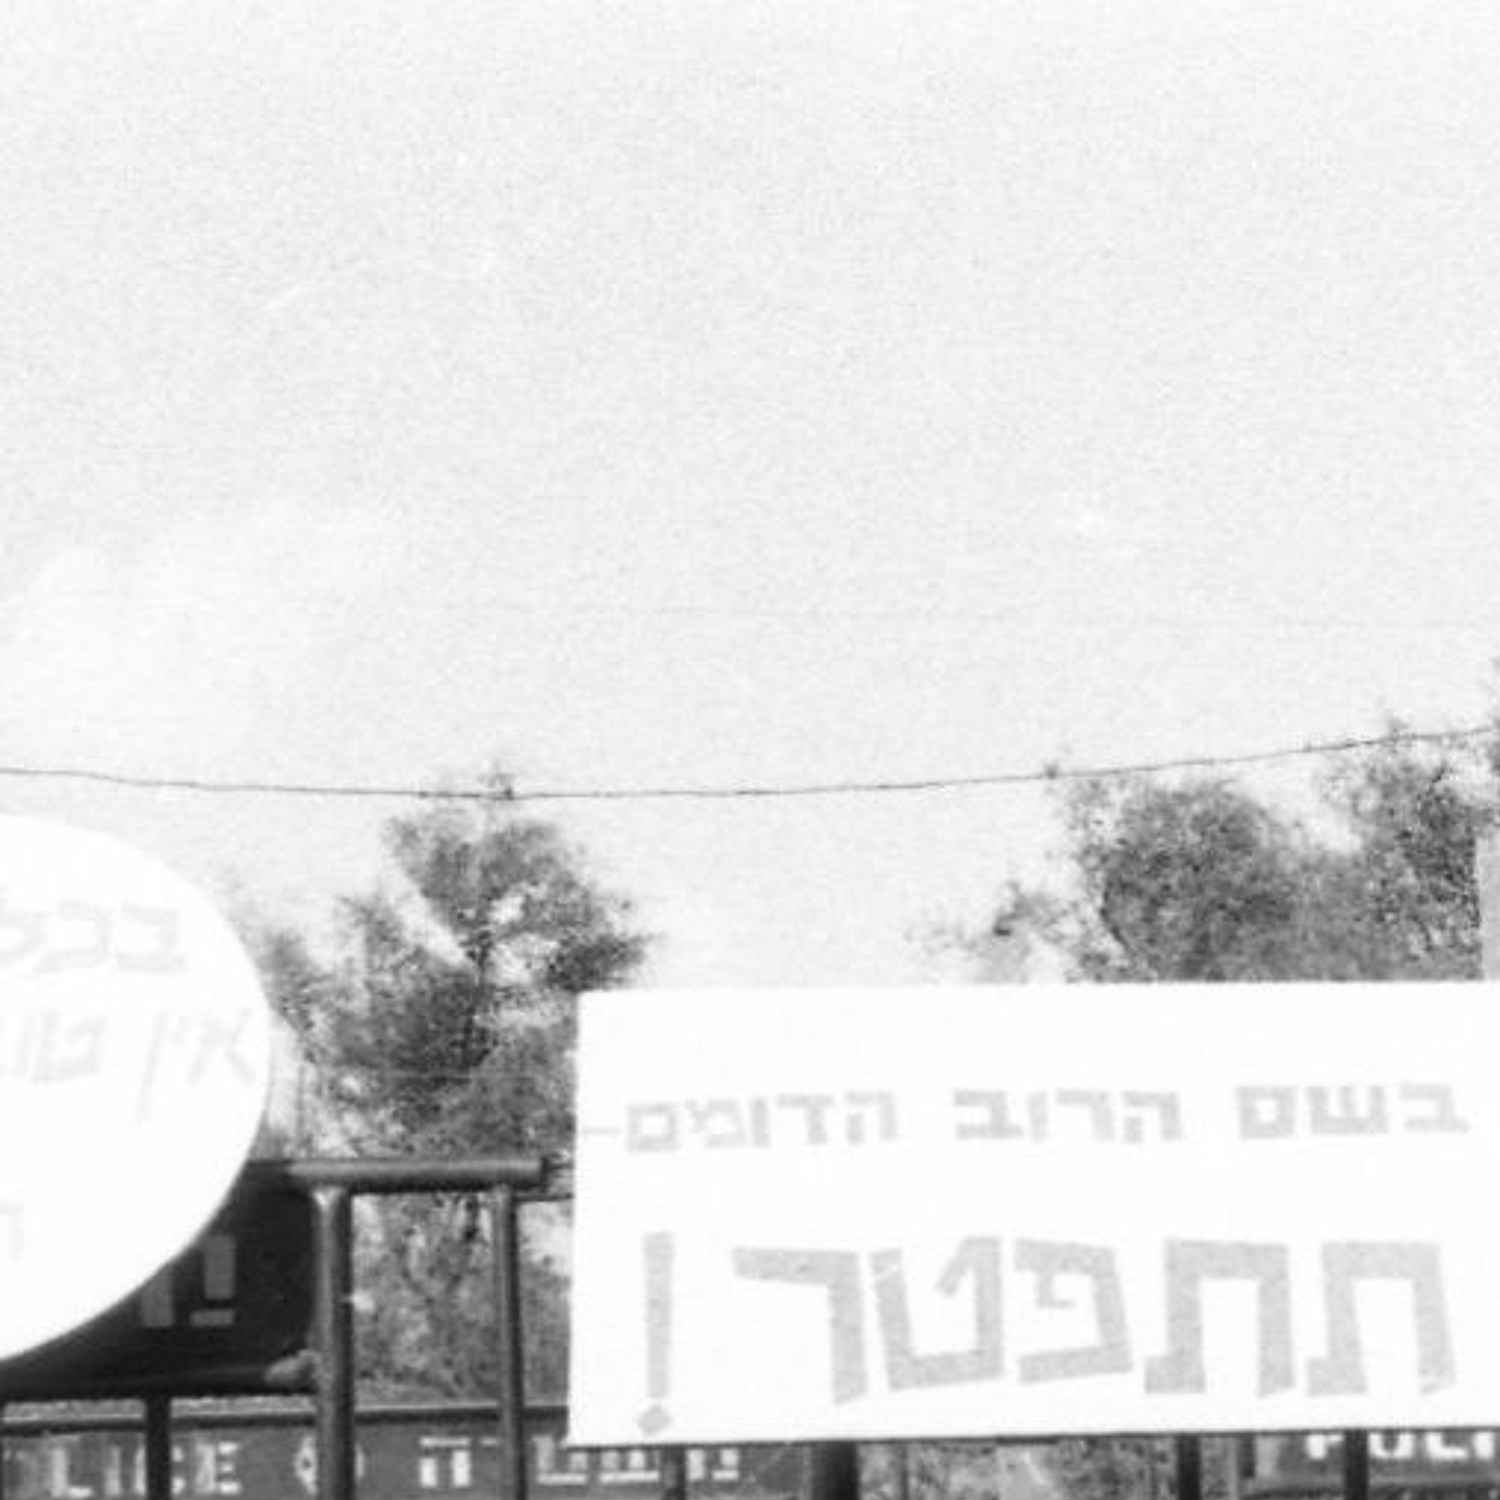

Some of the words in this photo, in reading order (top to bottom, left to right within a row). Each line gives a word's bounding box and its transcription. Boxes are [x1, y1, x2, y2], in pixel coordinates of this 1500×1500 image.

[0, 1009, 107, 1086] טו
[135, 1006, 257, 1127] אין
[952, 1087, 1184, 1146] הרוב
[1236, 1082, 1470, 1141] בשם
